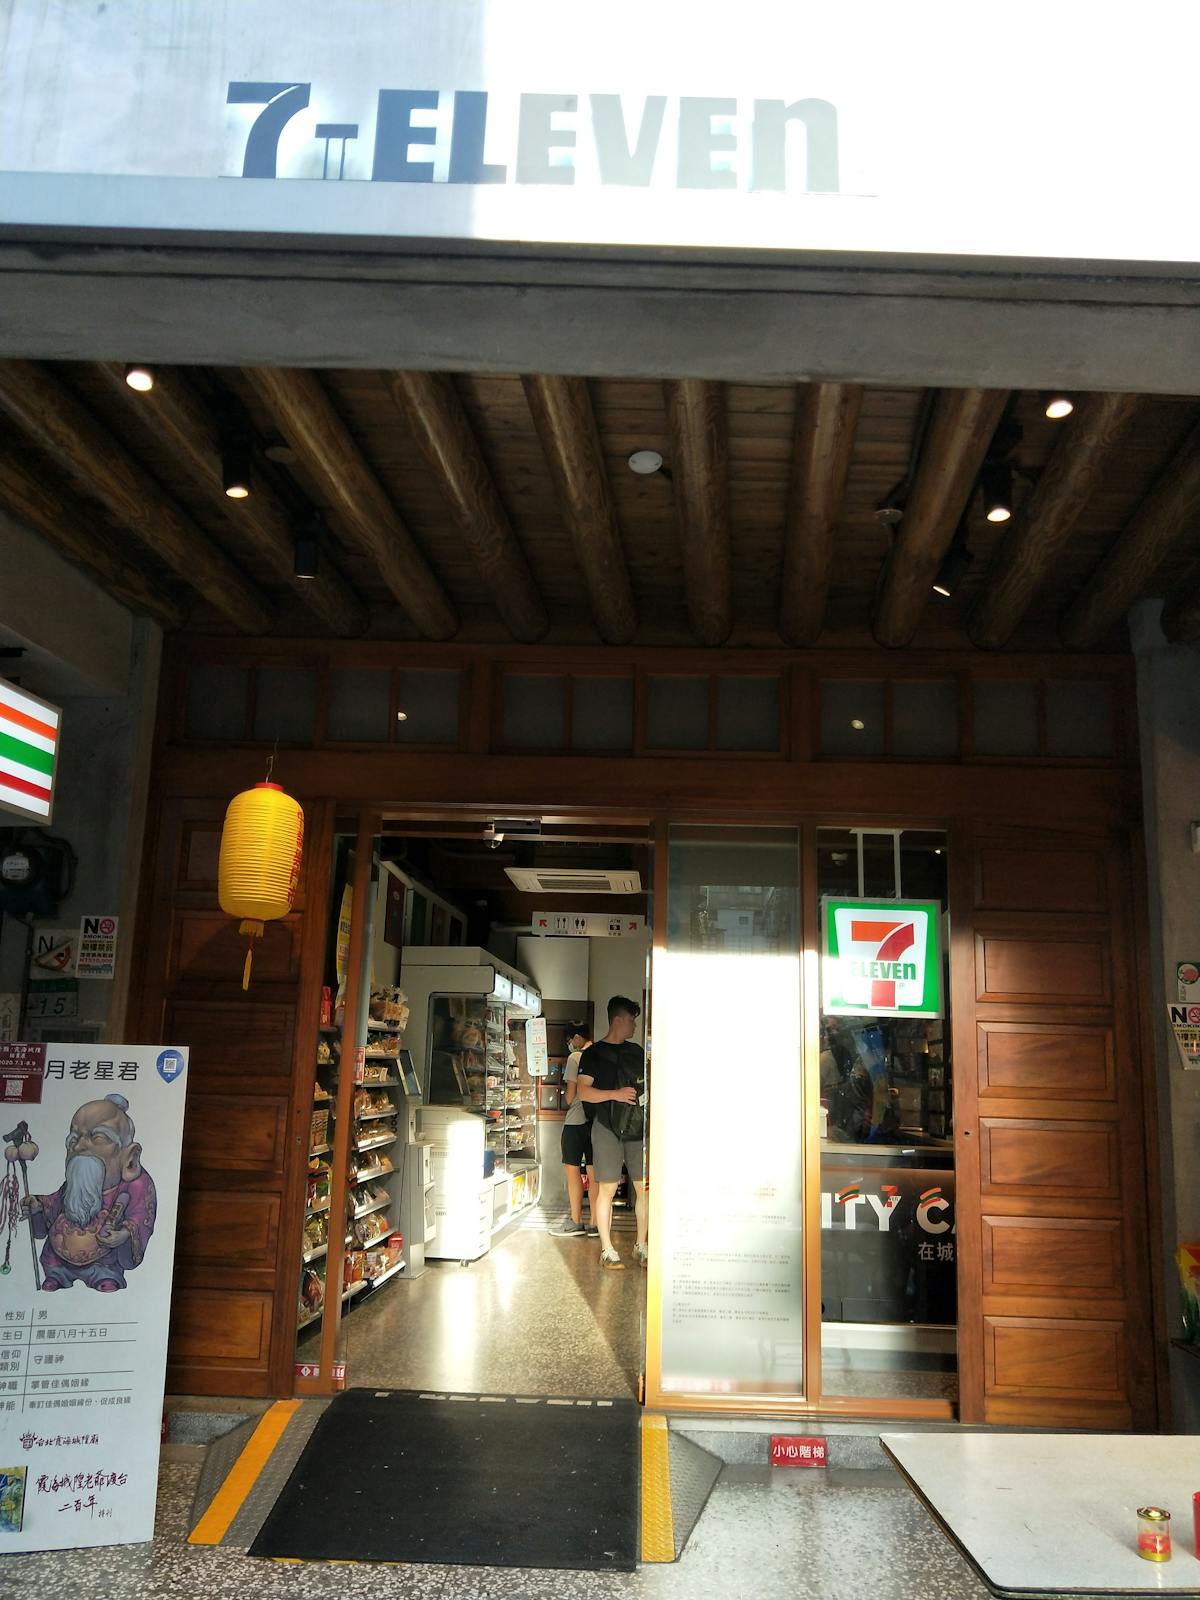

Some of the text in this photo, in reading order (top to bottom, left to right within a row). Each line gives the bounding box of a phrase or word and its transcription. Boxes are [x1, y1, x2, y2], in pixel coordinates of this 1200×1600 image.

[44, 1059, 139, 1081] 月老星君
[916, 1196, 956, 1234] C
[5, 1310, 25, 1321] 性別
[37, 1310, 48, 1320] 男
[2, 1330, 23, 1340] 生日
[772, 1444, 825, 1459] 小心階梯
[58, 1494, 98, 1519] 二百年
